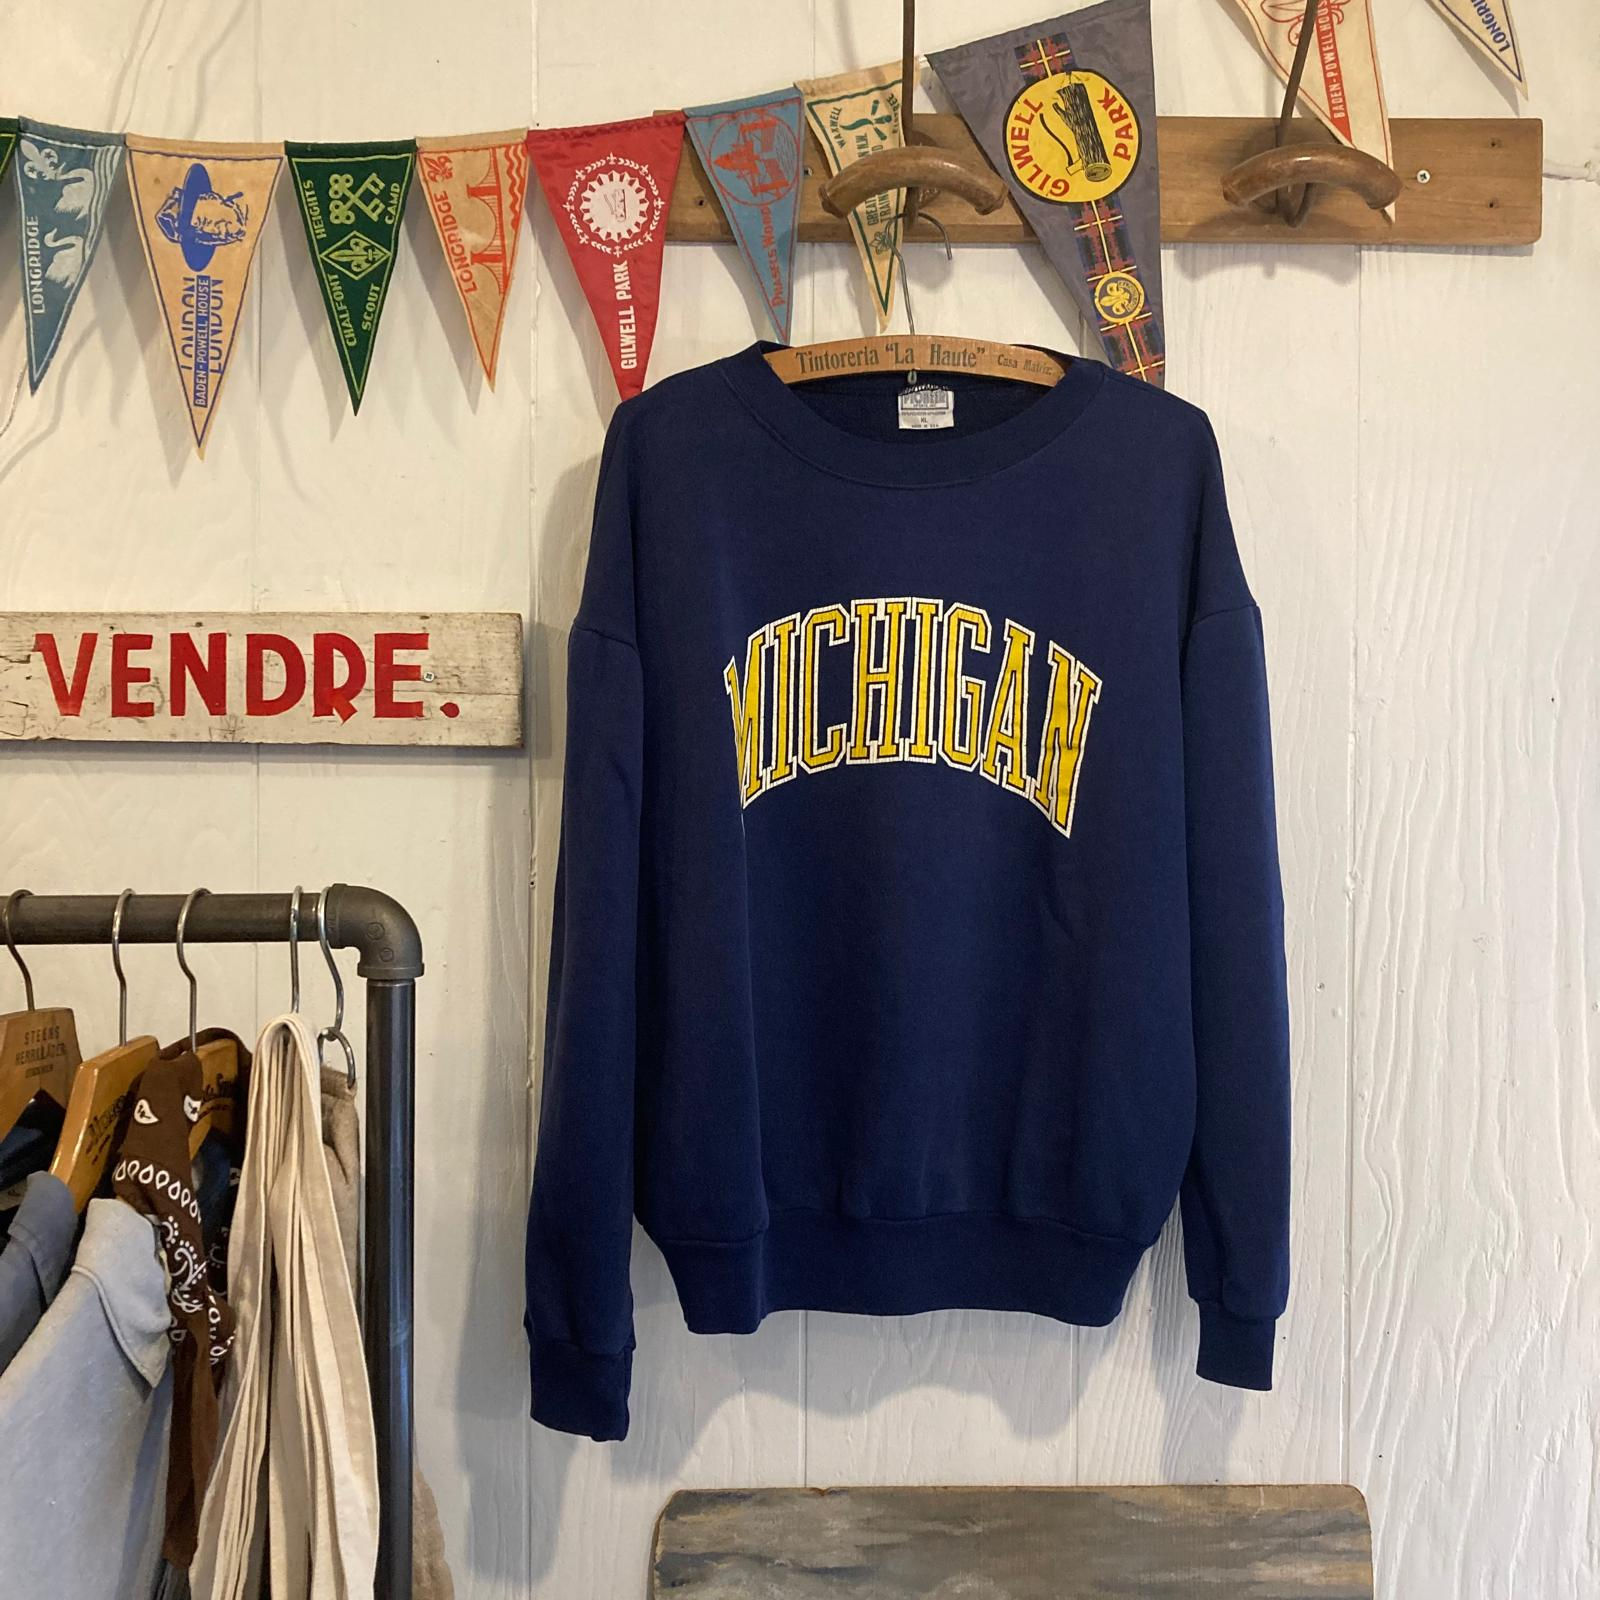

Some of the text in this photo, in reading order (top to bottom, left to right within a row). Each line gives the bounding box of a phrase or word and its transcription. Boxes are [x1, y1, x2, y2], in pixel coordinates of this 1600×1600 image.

[1317, 0, 1346, 119] BADEN-POWELL HOUS
[1010, 87, 1134, 197] GILWELL PARK
[27, 215, 45, 314] LONGRIDGE
[303, 179, 357, 347] CHALFONT HEIGHTS
[361, 182, 401, 332] SCOUT CAMP
[434, 190, 478, 294] LONGRIDGE
[194, 278, 210, 407] BADEN-POWELL HOUSE
[612, 260, 638, 370] GILWELL PARK
[796, 348, 879, 374] Tintoreria
[997, 354, 1018, 369] Casa
[33, 632, 461, 724] VENDRE.
[723, 597, 1102, 839] MICHIGAN
